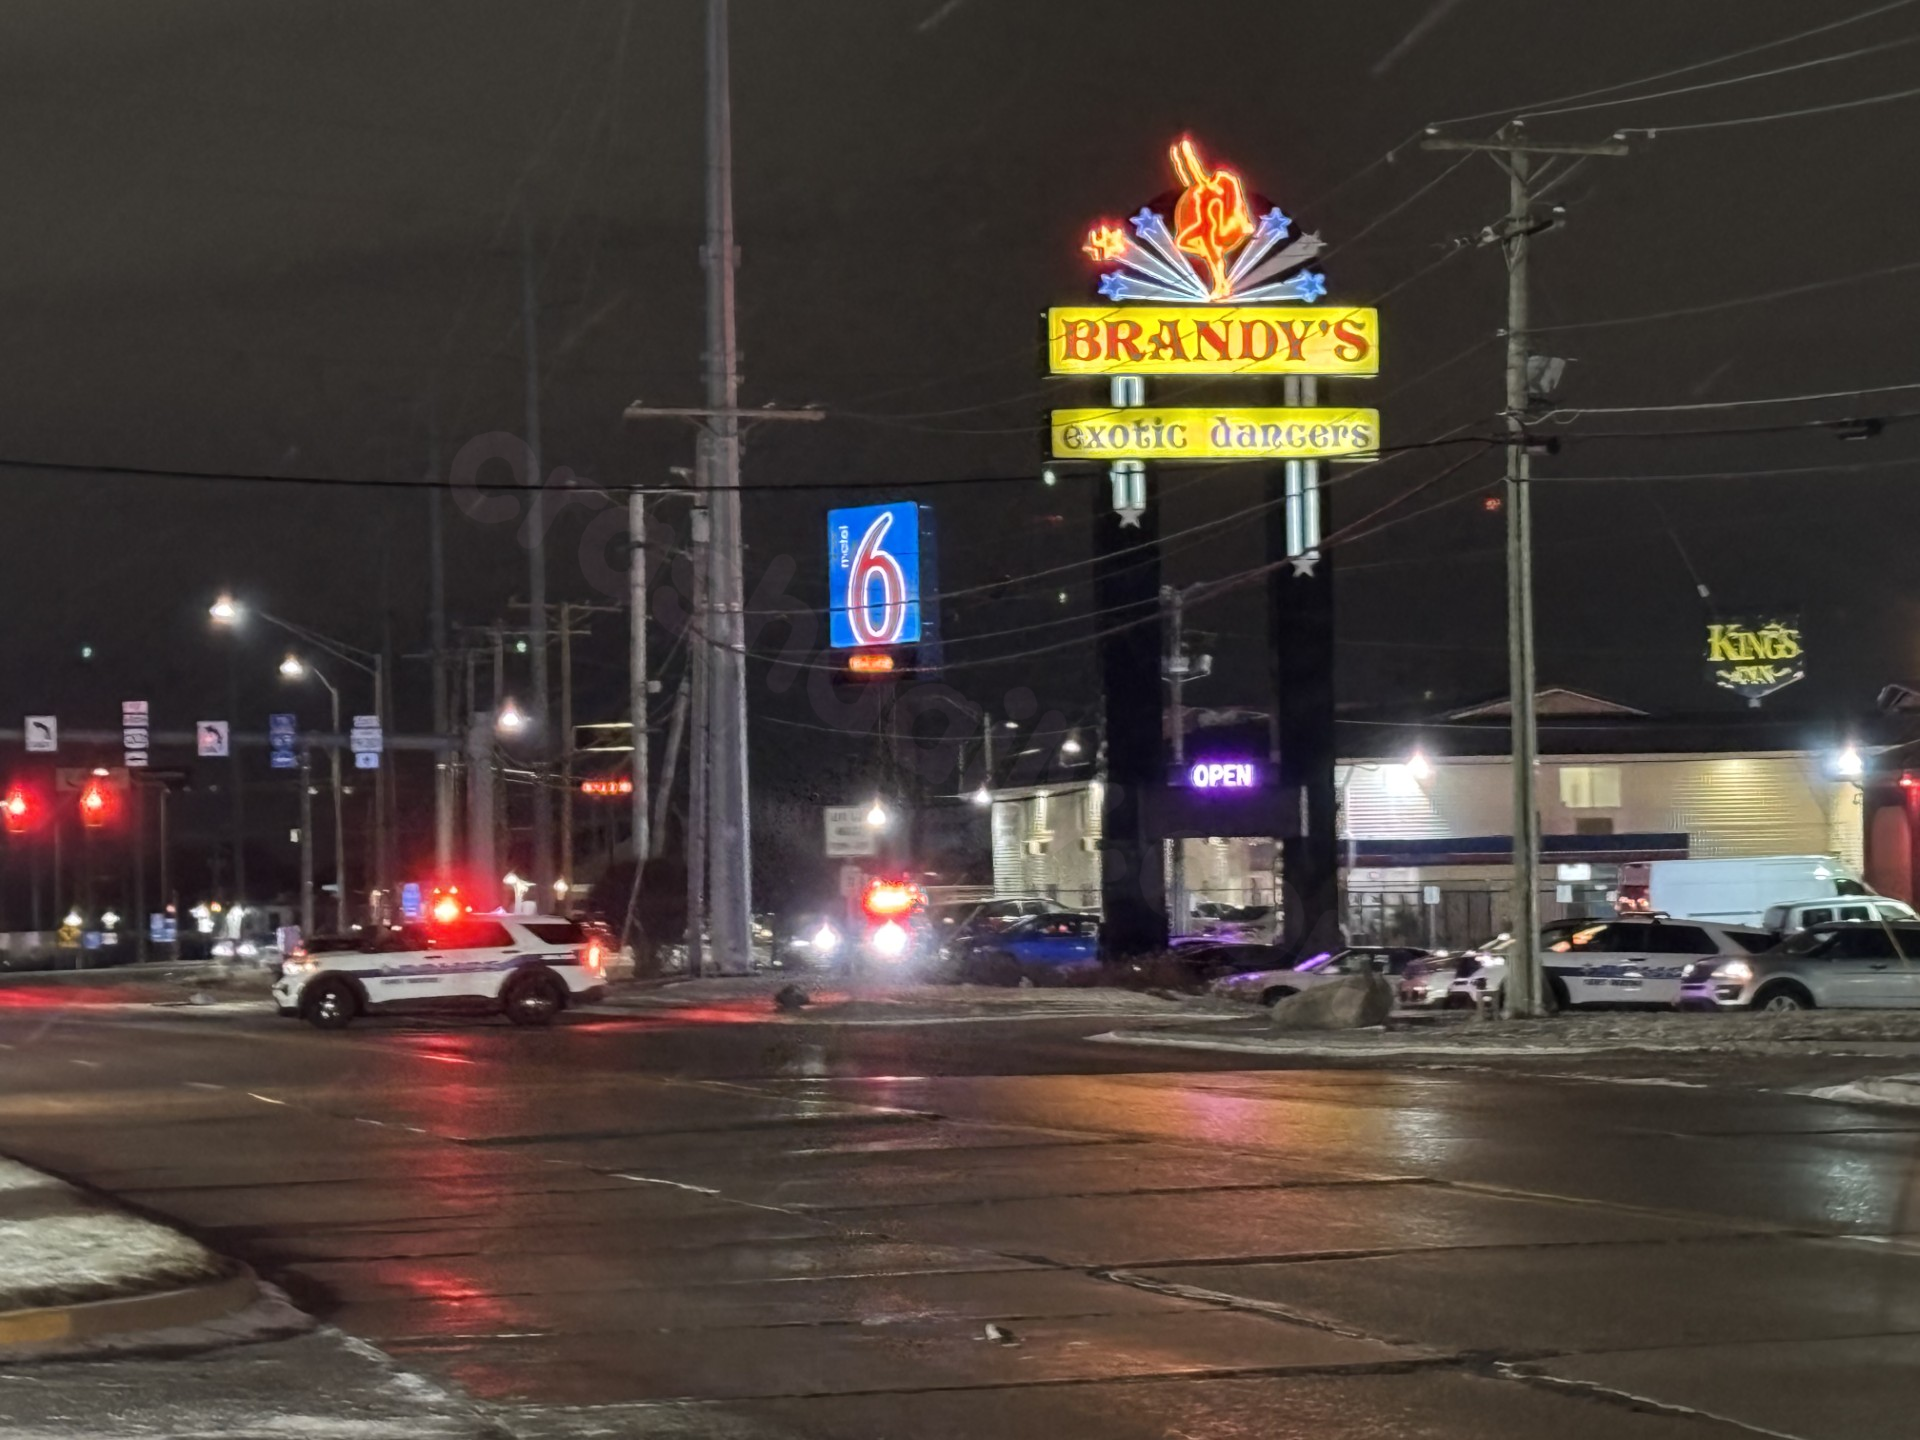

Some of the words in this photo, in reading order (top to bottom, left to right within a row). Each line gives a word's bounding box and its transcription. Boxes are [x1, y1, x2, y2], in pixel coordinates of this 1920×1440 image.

[1061, 318, 1370, 362] BRANDY'S
[1062, 417, 1188, 450] exotic
[1210, 416, 1371, 450] dancers
[848, 511, 906, 644] 6
[1191, 763, 1254, 788] OPEN
